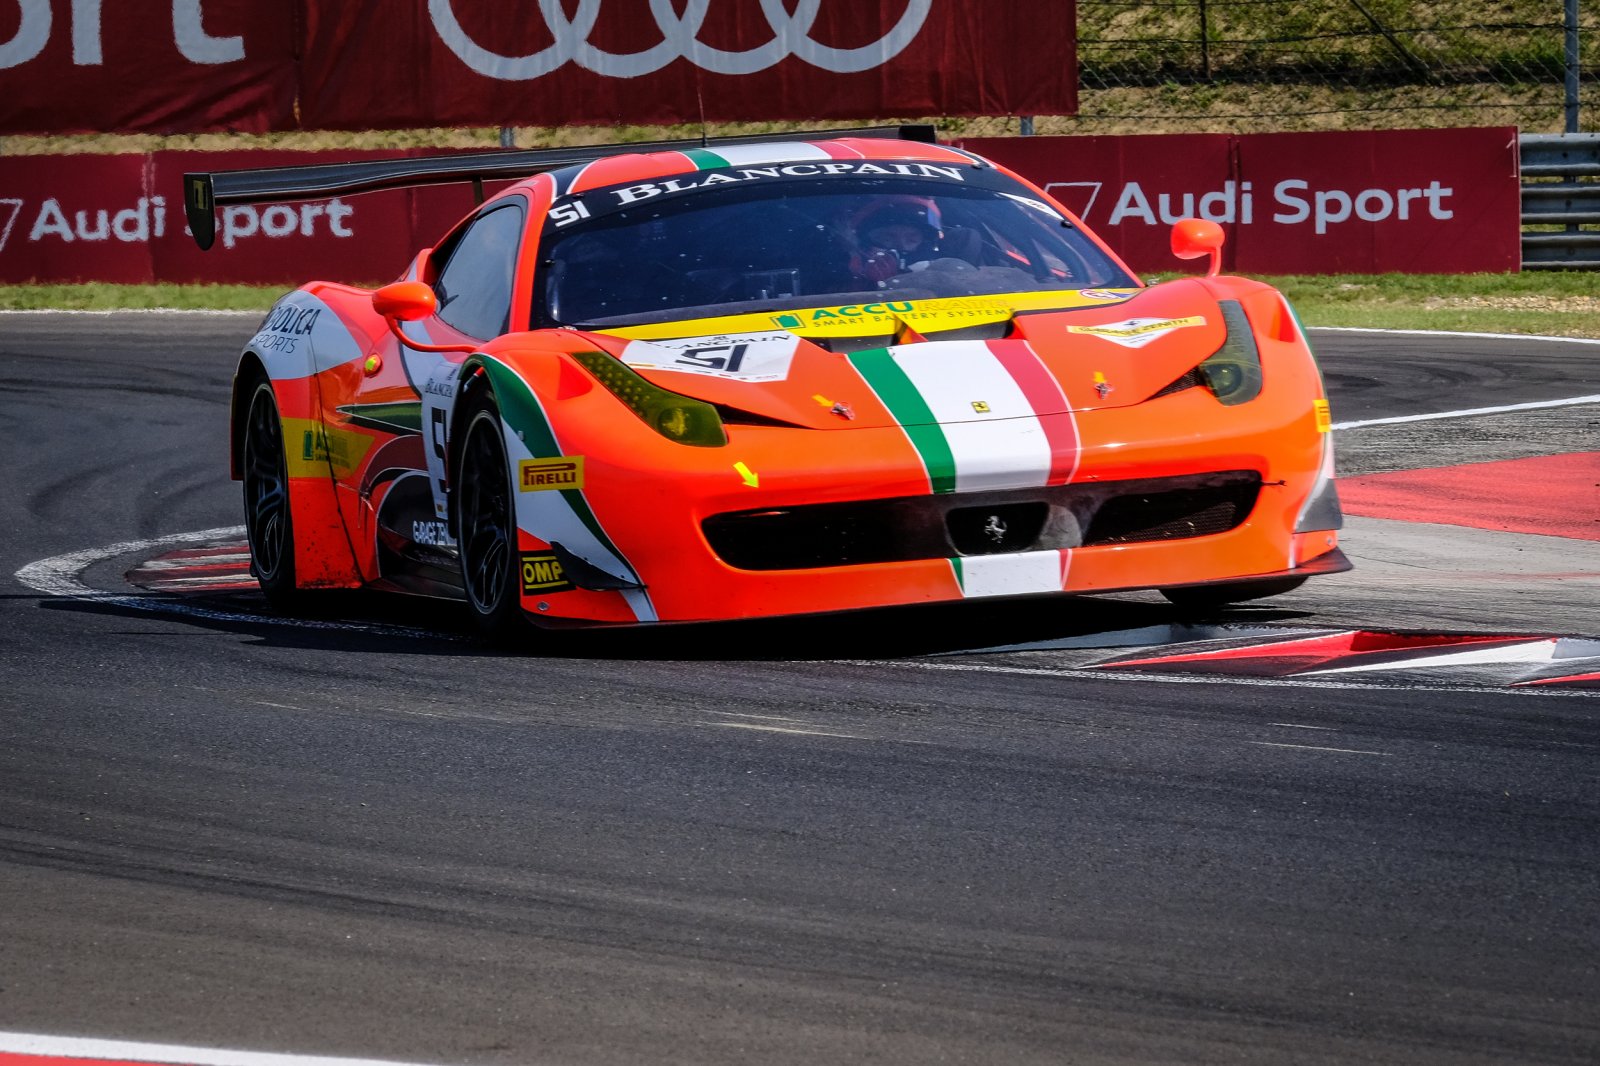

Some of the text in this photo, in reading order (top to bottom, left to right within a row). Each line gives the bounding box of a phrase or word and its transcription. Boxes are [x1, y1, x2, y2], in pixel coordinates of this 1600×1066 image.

[610, 163, 964, 206] BLANCPAIN
[29, 195, 354, 249] Audi port
[1108, 179, 1454, 235] Audi Sport
[813, 317, 865, 328] SMART
[873, 312, 937, 322] BATERY
[523, 462, 577, 486] PIRELLI
[523, 561, 563, 584] OMP
